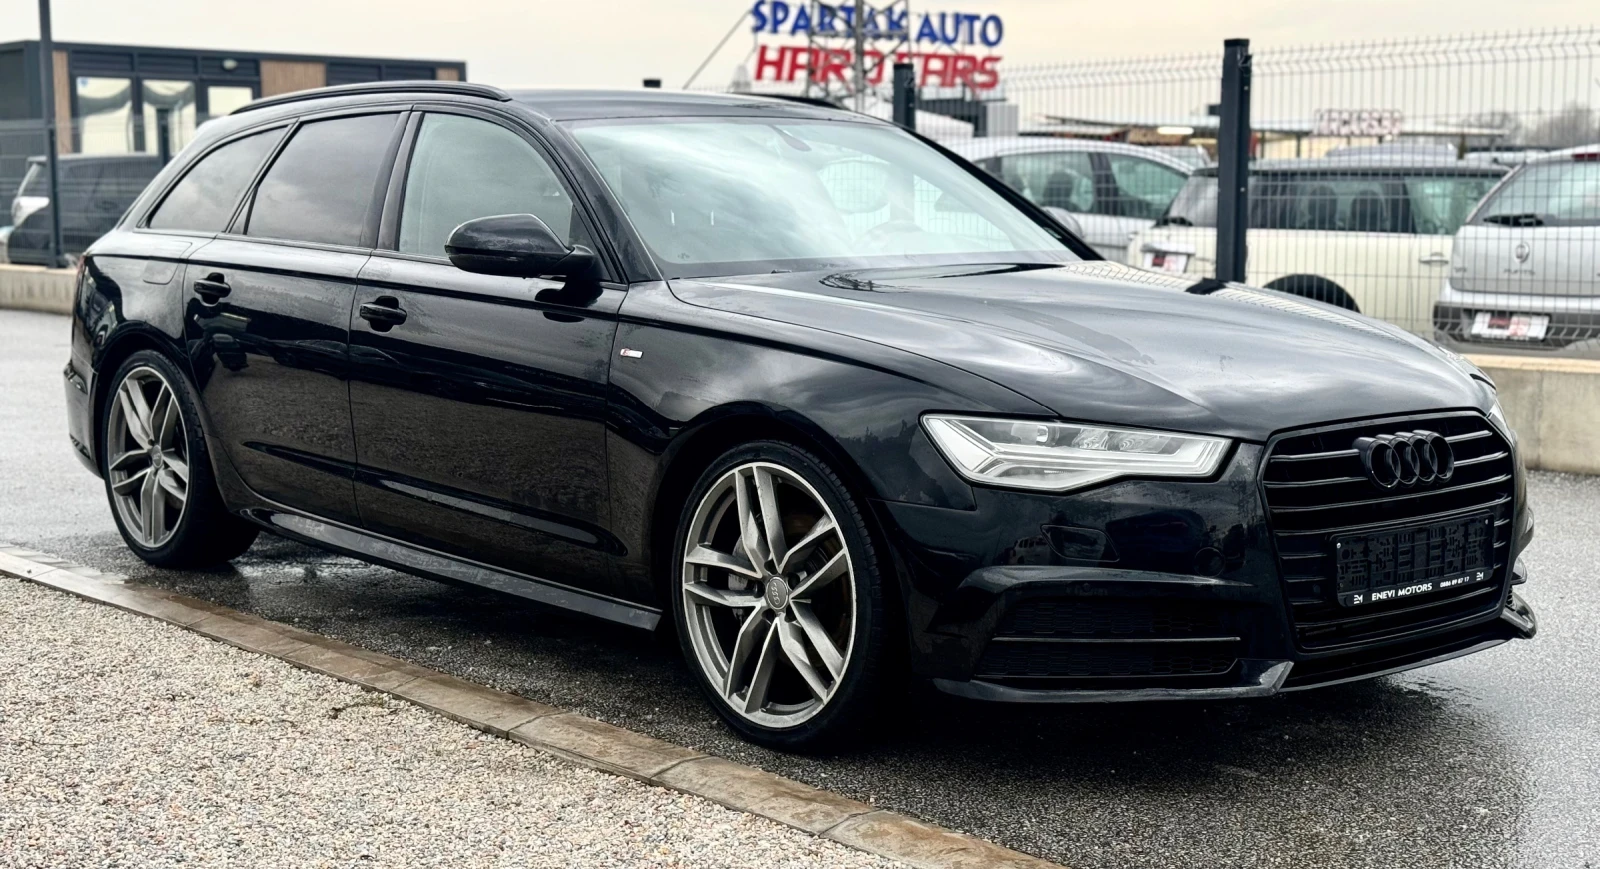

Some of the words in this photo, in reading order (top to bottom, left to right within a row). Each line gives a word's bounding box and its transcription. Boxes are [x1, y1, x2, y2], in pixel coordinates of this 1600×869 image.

[916, 13, 1004, 47] AUTO
[754, 44, 884, 85] HARD
[1371, 590, 1396, 601] ENEVI
[1397, 583, 1433, 596] MOTORS
